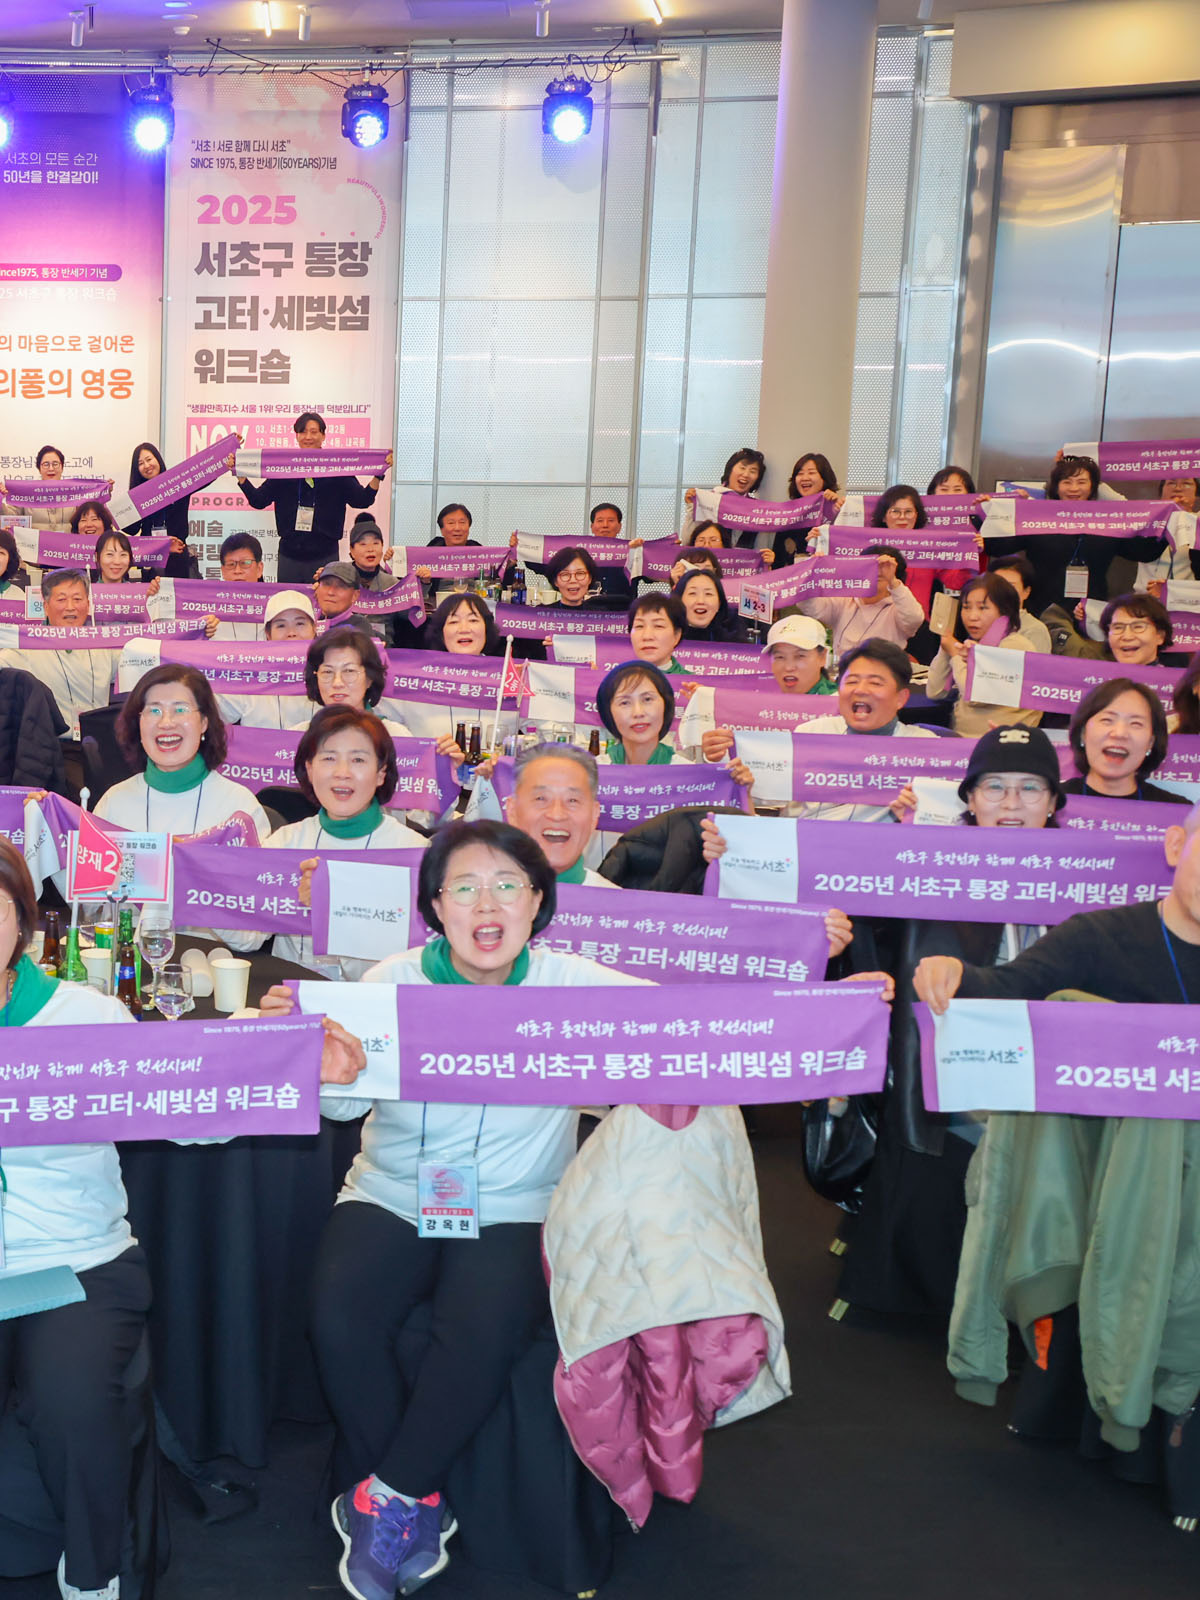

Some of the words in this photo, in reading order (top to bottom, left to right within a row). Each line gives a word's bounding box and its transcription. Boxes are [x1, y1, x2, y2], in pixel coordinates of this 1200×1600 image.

[217, 139, 233, 153] 서로
[235, 139, 250, 153] 함께
[253, 139, 269, 153] 다시
[4, 152, 42, 165] 서초의
[45, 152, 70, 166] 모든
[73, 152, 99, 166] 순간
[190, 157, 214, 169] SINCE
[216, 157, 237, 170] 1975,
[238, 157, 255, 170] 통장
[3, 170, 42, 184] 50년을
[46, 170, 99, 185] 한결같이!
[196, 194, 298, 225] 2025
[194, 241, 294, 278] 서초구
[305, 241, 373, 278] 통장
[41, 267, 59, 279] 통장
[61, 267, 88, 279] 반세기
[90, 267, 108, 279] 기념
[194, 295, 370, 331] 고터·세빛섬
[18, 335, 83, 353] 마음으로
[88, 335, 135, 354] 걸어온
[194, 348, 291, 385] 워크숍
[81, 368, 135, 400] 영웅
[241, 403, 257, 414] 서울
[259, 403, 274, 414] 1위!
[275, 403, 291, 414] 우리
[293, 403, 325, 415] 통장님들
[255, 424, 268, 434] 03.
[1105, 462, 1141, 472] 2025년
[1143, 460, 1170, 471] 서초구
[188, 519, 223, 538] 예술
[743, 597, 751, 609] 서
[753, 600, 766, 613] 2-3
[27, 626, 67, 639] 2025년
[69, 627, 99, 638] 서초구
[804, 772, 865, 789] 2025년
[868, 774, 913, 790] 서초구
[814, 873, 894, 896] 2025년
[899, 876, 963, 899] 서초구
[967, 878, 1010, 901] 통장
[1014, 880, 1129, 905] 고터·세빛섬
[578, 939, 622, 966] 통장
[625, 944, 739, 976] 고터·세빛섬
[743, 955, 810, 983] 워크숍
[516, 1019, 555, 1038] 서초구
[559, 1020, 616, 1039] 통장님과
[622, 1020, 658, 1037] 함께
[663, 1018, 703, 1037] 서초구
[708, 1018, 774, 1037] 전성시대!
[47, 1060, 83, 1078] 함께
[89, 1058, 130, 1078] 서초구
[136, 1056, 203, 1076] 전성시대!
[419, 1053, 516, 1079] 2025년
[522, 1052, 597, 1080] 서초구
[602, 1052, 652, 1080] 통장
[659, 1050, 793, 1079] 고터·세빛섬
[799, 1046, 868, 1077] 워크숍
[1055, 1065, 1157, 1093] 2025년
[26, 1095, 77, 1122] 통장
[83, 1086, 219, 1118] 고터·세빛섬
[225, 1082, 301, 1111] 워크숍
